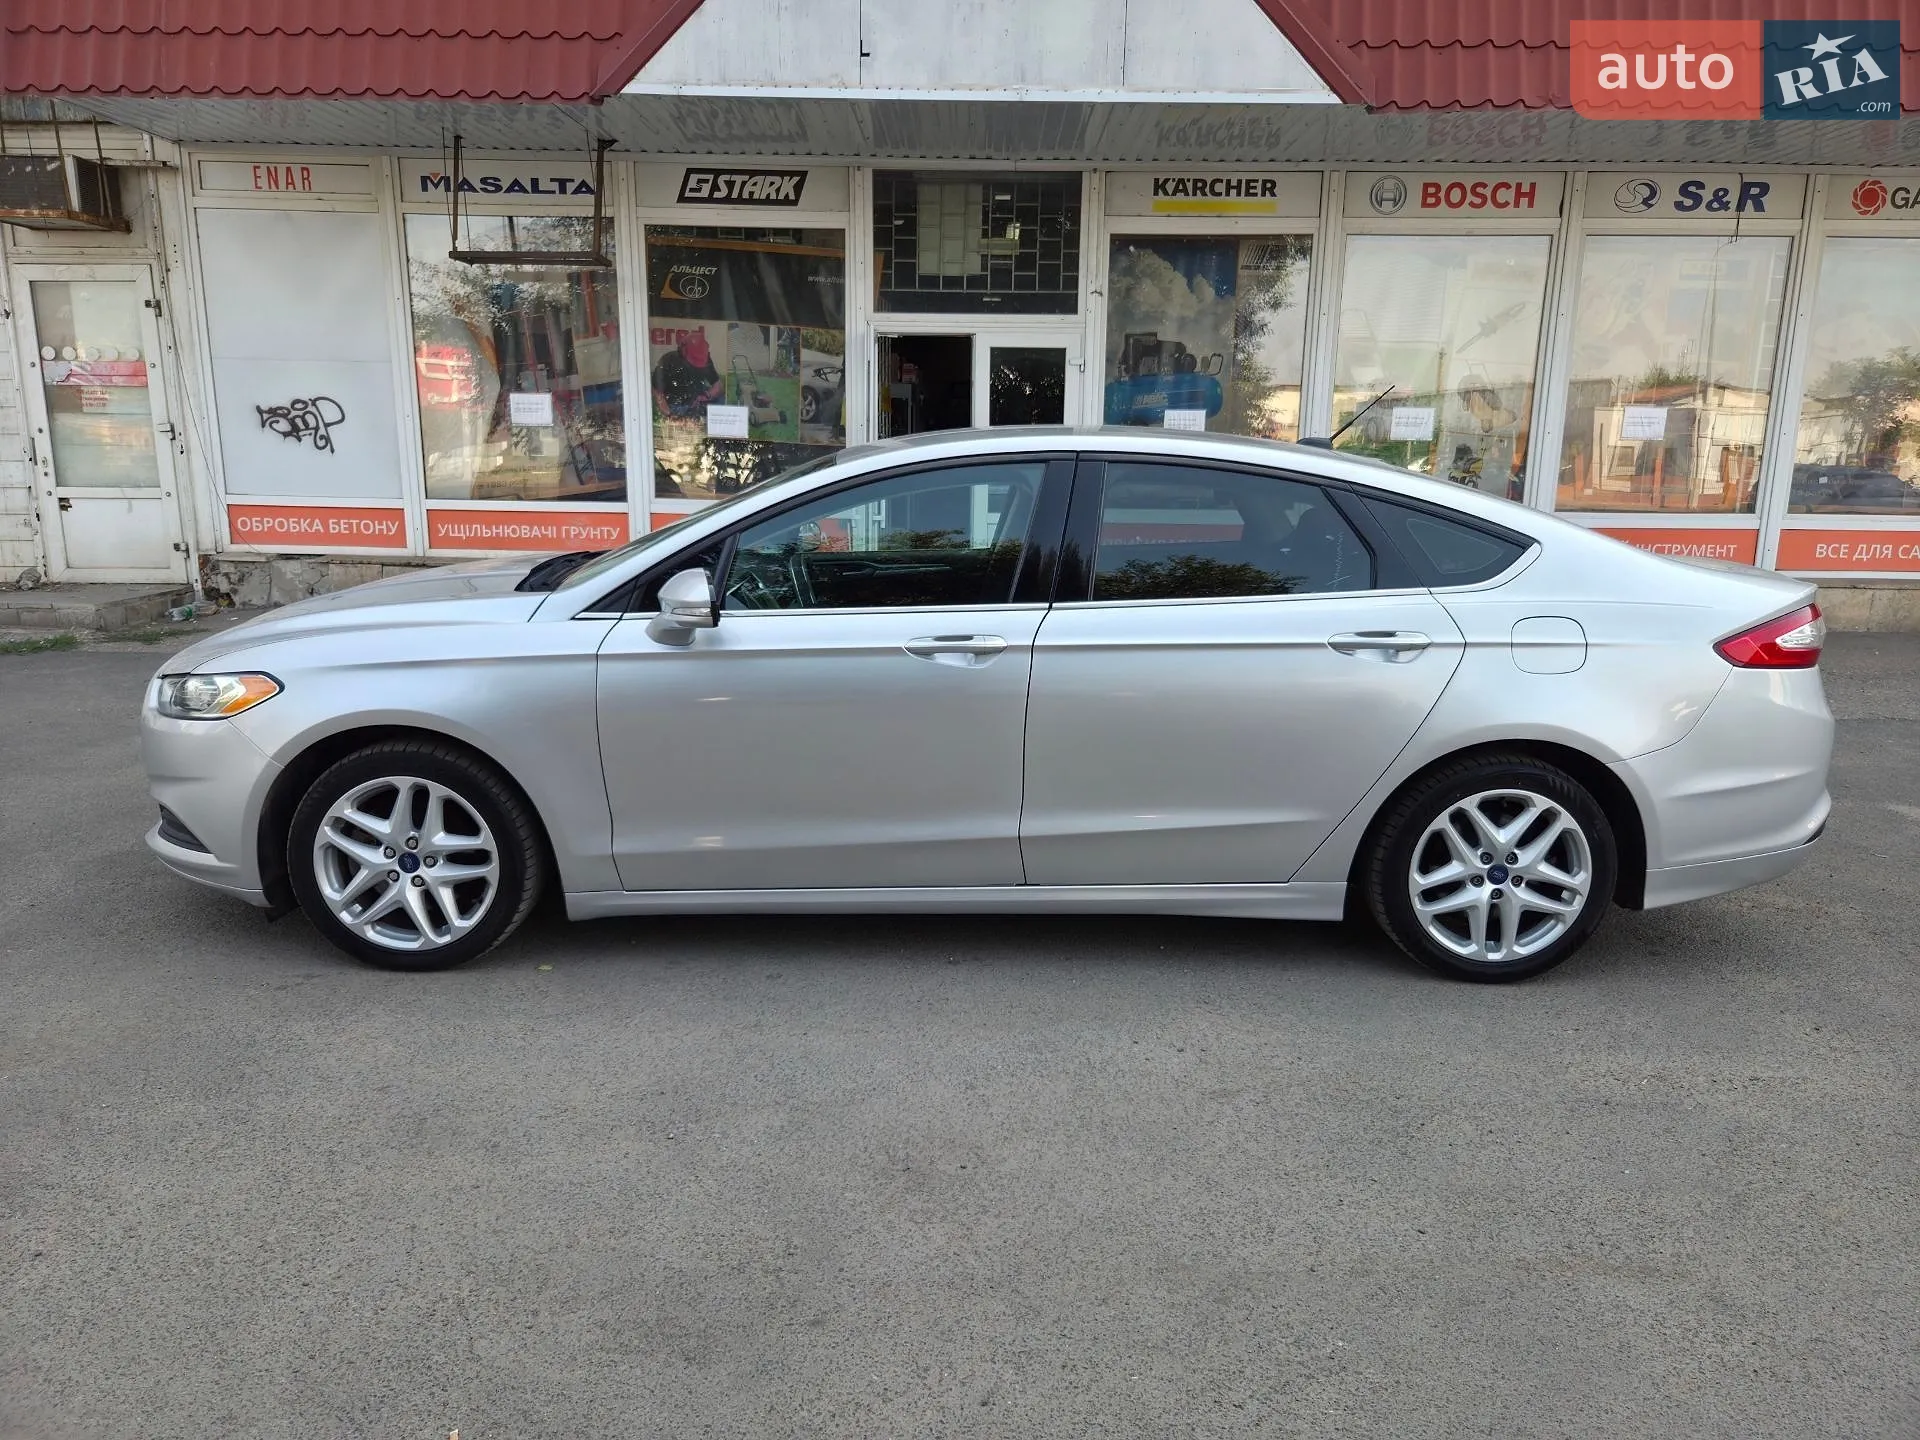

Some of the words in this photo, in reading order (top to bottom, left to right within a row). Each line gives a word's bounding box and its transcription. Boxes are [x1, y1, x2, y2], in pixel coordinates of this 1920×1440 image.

[252, 165, 313, 192] ENAR
[420, 173, 597, 196] MASALTA
[712, 174, 801, 200] STARK
[1152, 177, 1278, 198] KÄRCHER
[1420, 181, 1537, 210] BOSCH
[1673, 180, 1771, 213] S&R
[670, 264, 718, 276] АЛЬЦЕСТ
[237, 516, 325, 534] ОБРОБКА
[328, 518, 400, 536] БЕТОНУ
[437, 523, 557, 540] УЩІЛЬНЮВАЧІ
[1815, 543, 1850, 559] ВСЕ
[1852, 543, 1893, 562] ДЛЯ
